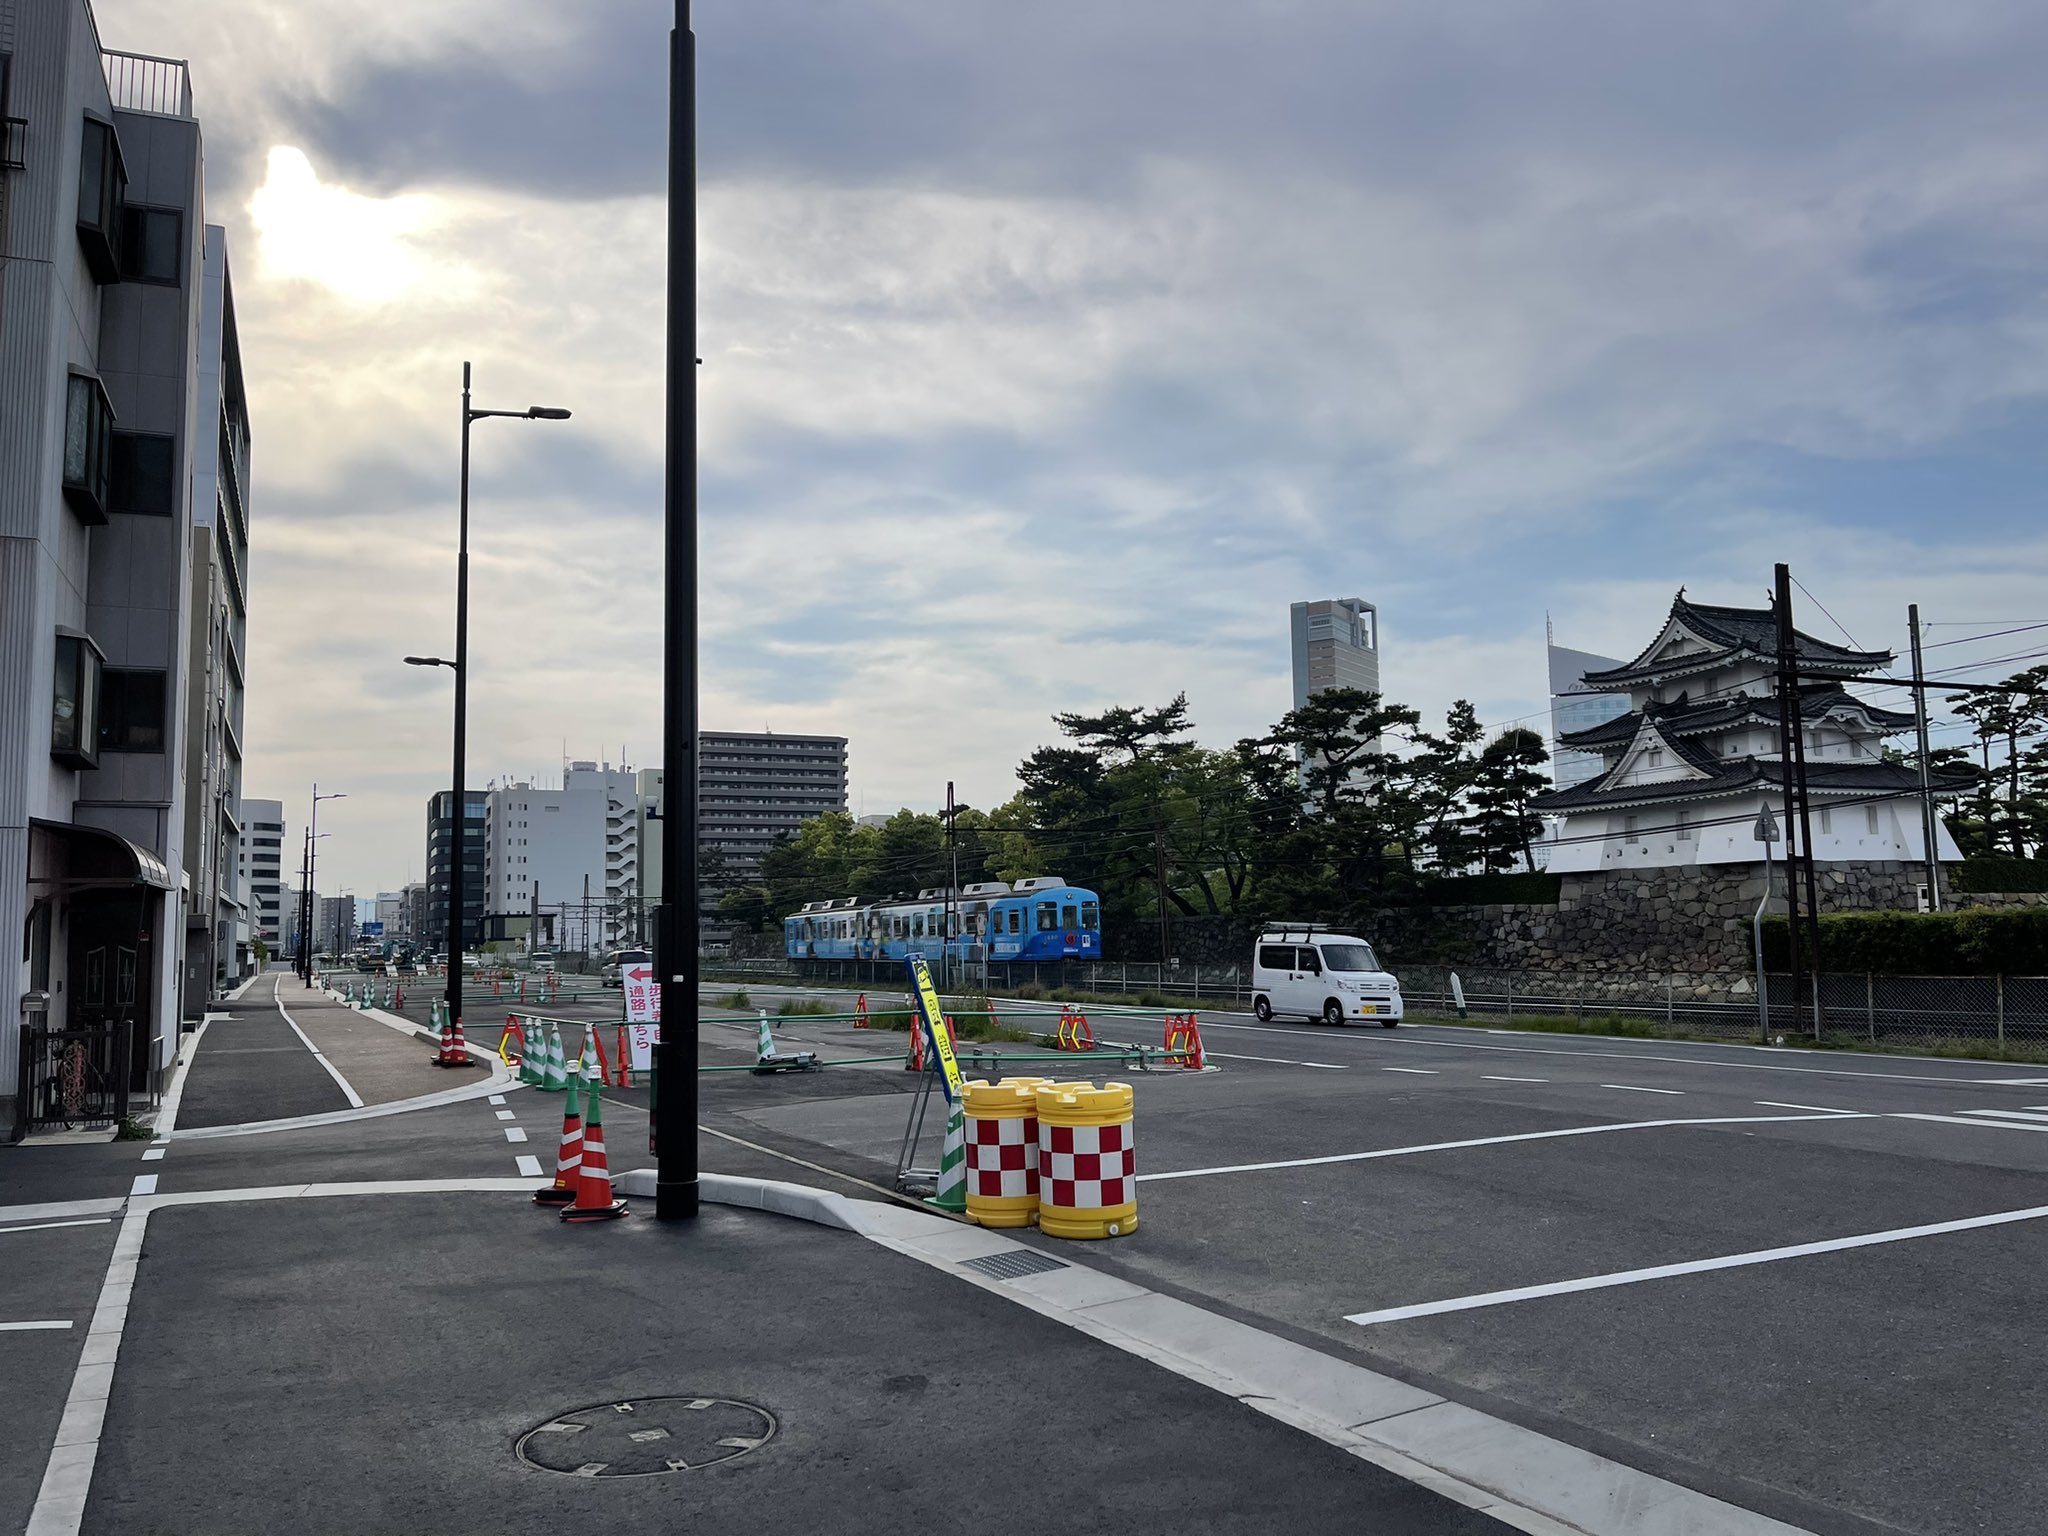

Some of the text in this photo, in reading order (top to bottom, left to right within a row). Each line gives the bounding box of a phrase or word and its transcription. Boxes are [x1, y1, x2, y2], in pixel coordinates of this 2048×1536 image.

[629, 986, 649, 1049] 通路こちら
